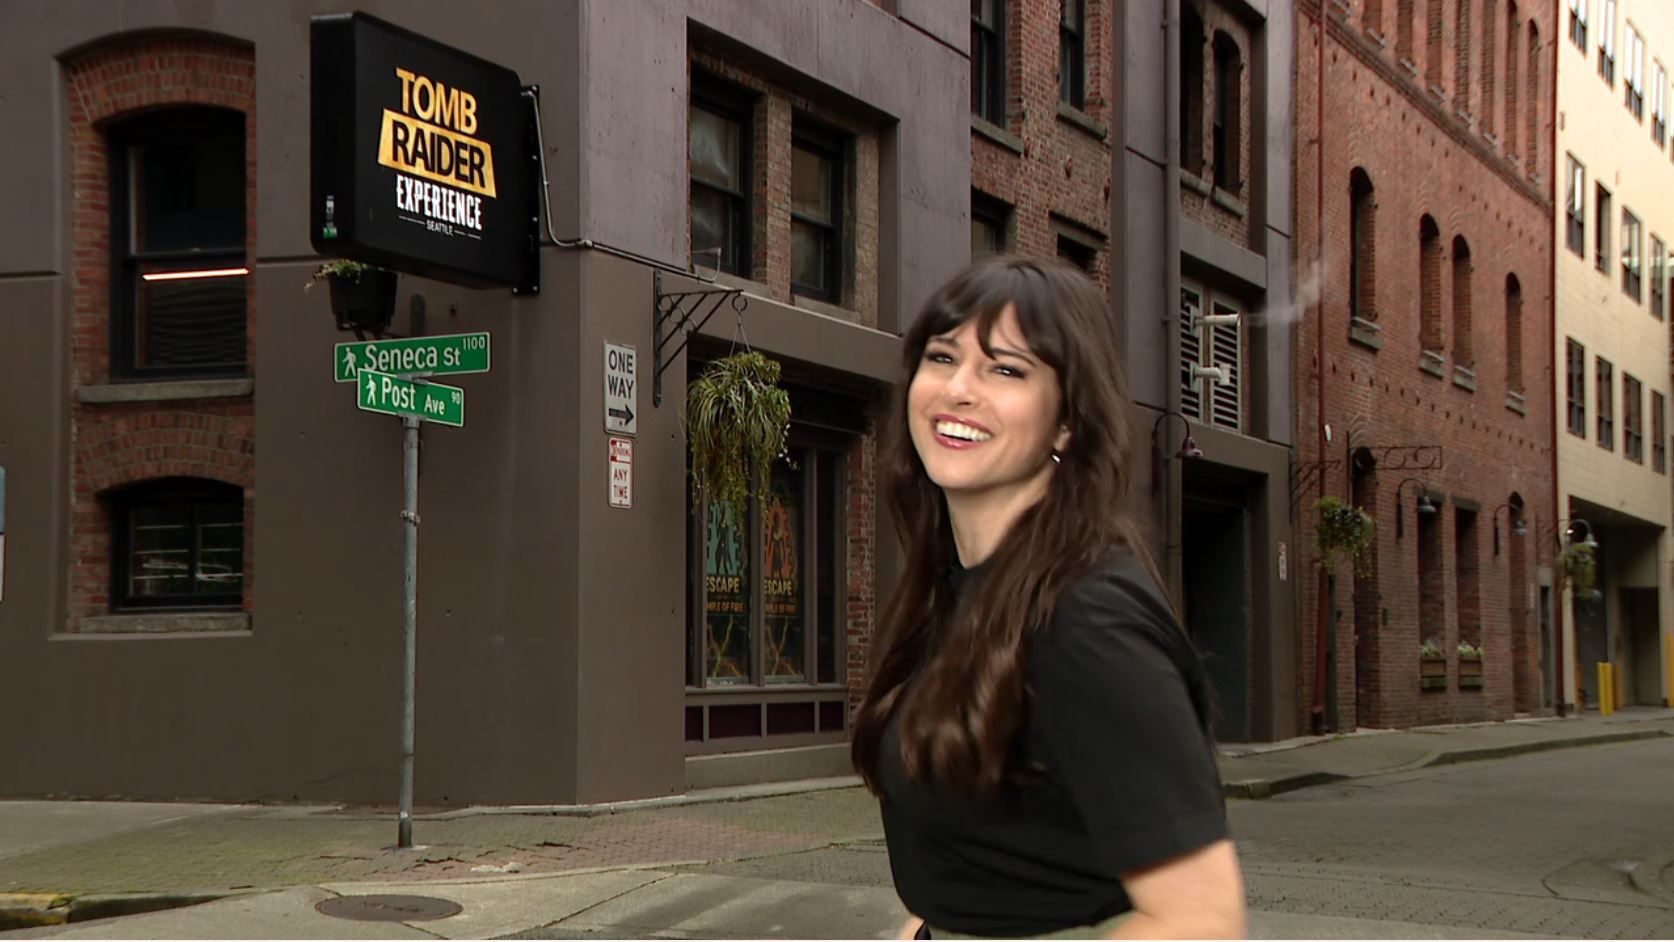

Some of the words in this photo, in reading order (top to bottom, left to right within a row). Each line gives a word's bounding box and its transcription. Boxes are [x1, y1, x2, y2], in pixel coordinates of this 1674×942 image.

[396, 67, 477, 135] TOMB
[392, 119, 487, 189] RAIDER
[396, 174, 482, 231] EXPERIENCE
[426, 219, 454, 236] SEATTLE
[364, 344, 438, 371] Seneca
[463, 336, 485, 350] 1100
[608, 350, 633, 374] ONE
[381, 377, 416, 410] Post
[424, 394, 445, 415] Ave
[451, 391, 460, 405] 90
[608, 374, 634, 400] WAY
[614, 469, 627, 481] ANY
